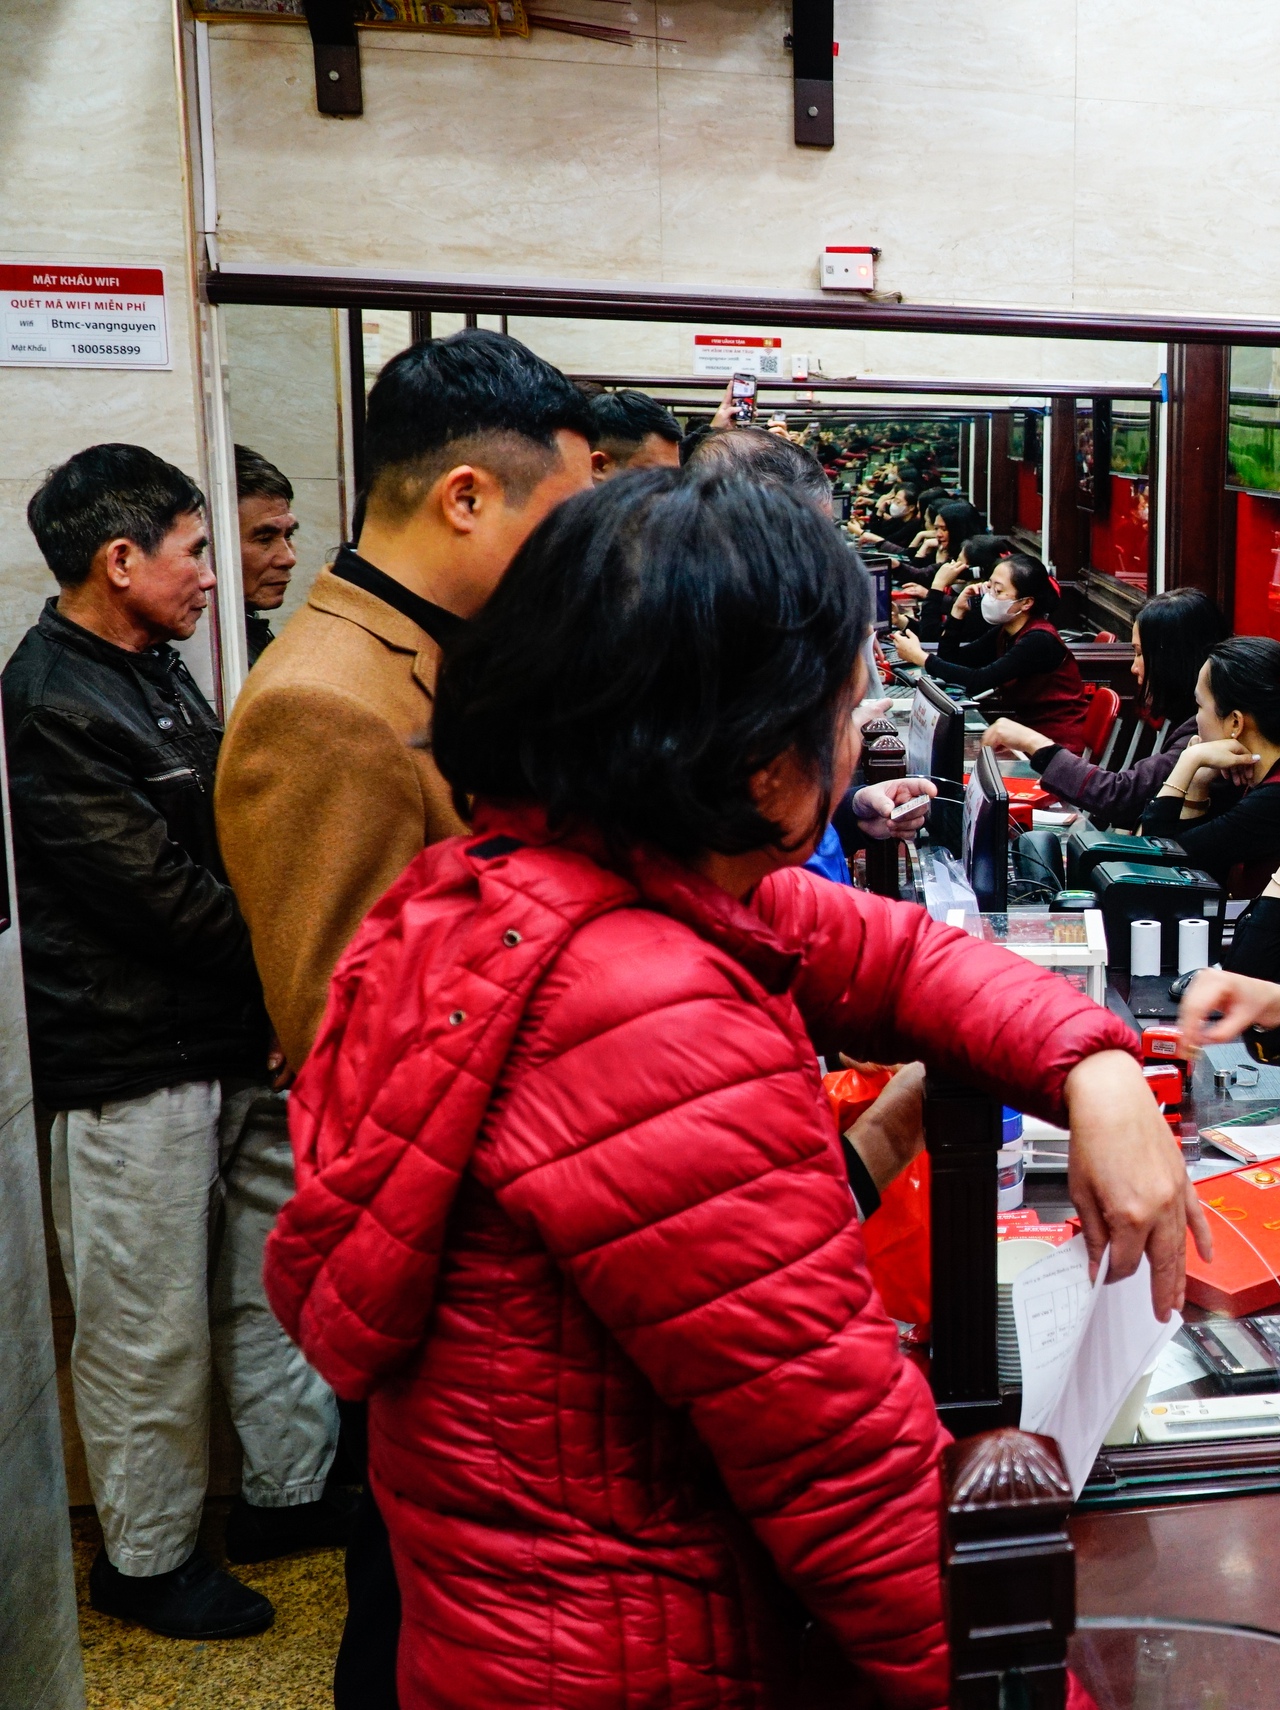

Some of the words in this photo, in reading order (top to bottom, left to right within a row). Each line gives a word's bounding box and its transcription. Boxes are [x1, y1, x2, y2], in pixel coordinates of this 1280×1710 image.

[32, 273, 57, 288] MẬT
[60, 272, 92, 287] KHẨU
[94, 277, 120, 287] WIFI
[10, 299, 41, 309] QUÉT
[45, 298, 63, 309] MÃ
[66, 301, 91, 310] WIFI
[94, 299, 123, 311] MIỄN
[126, 301, 146, 311] PHÍ
[51, 318, 157, 333] Btmc-vangnguyen
[71, 344, 141, 355] 1800585899
